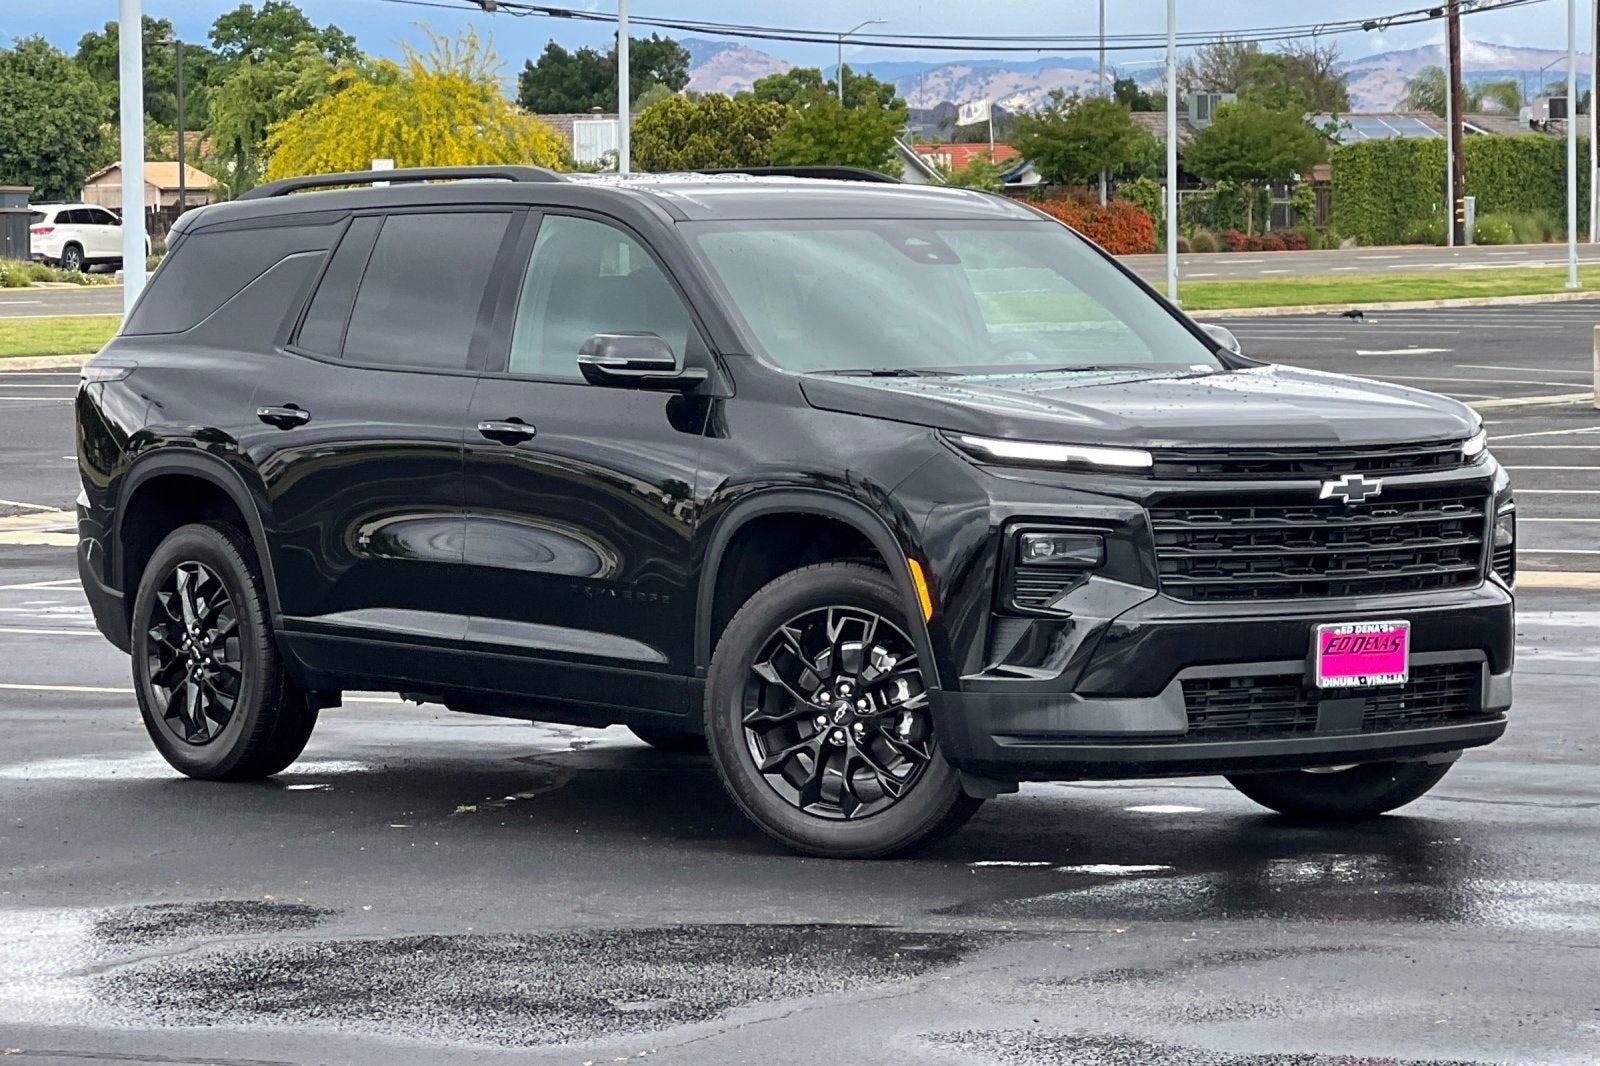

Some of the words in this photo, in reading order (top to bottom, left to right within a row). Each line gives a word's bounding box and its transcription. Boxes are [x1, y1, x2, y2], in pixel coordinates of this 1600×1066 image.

[1342, 626, 1353, 634] ED
[1322, 636, 1352, 656] ED
[1322, 676, 1360, 687] DINUBA
